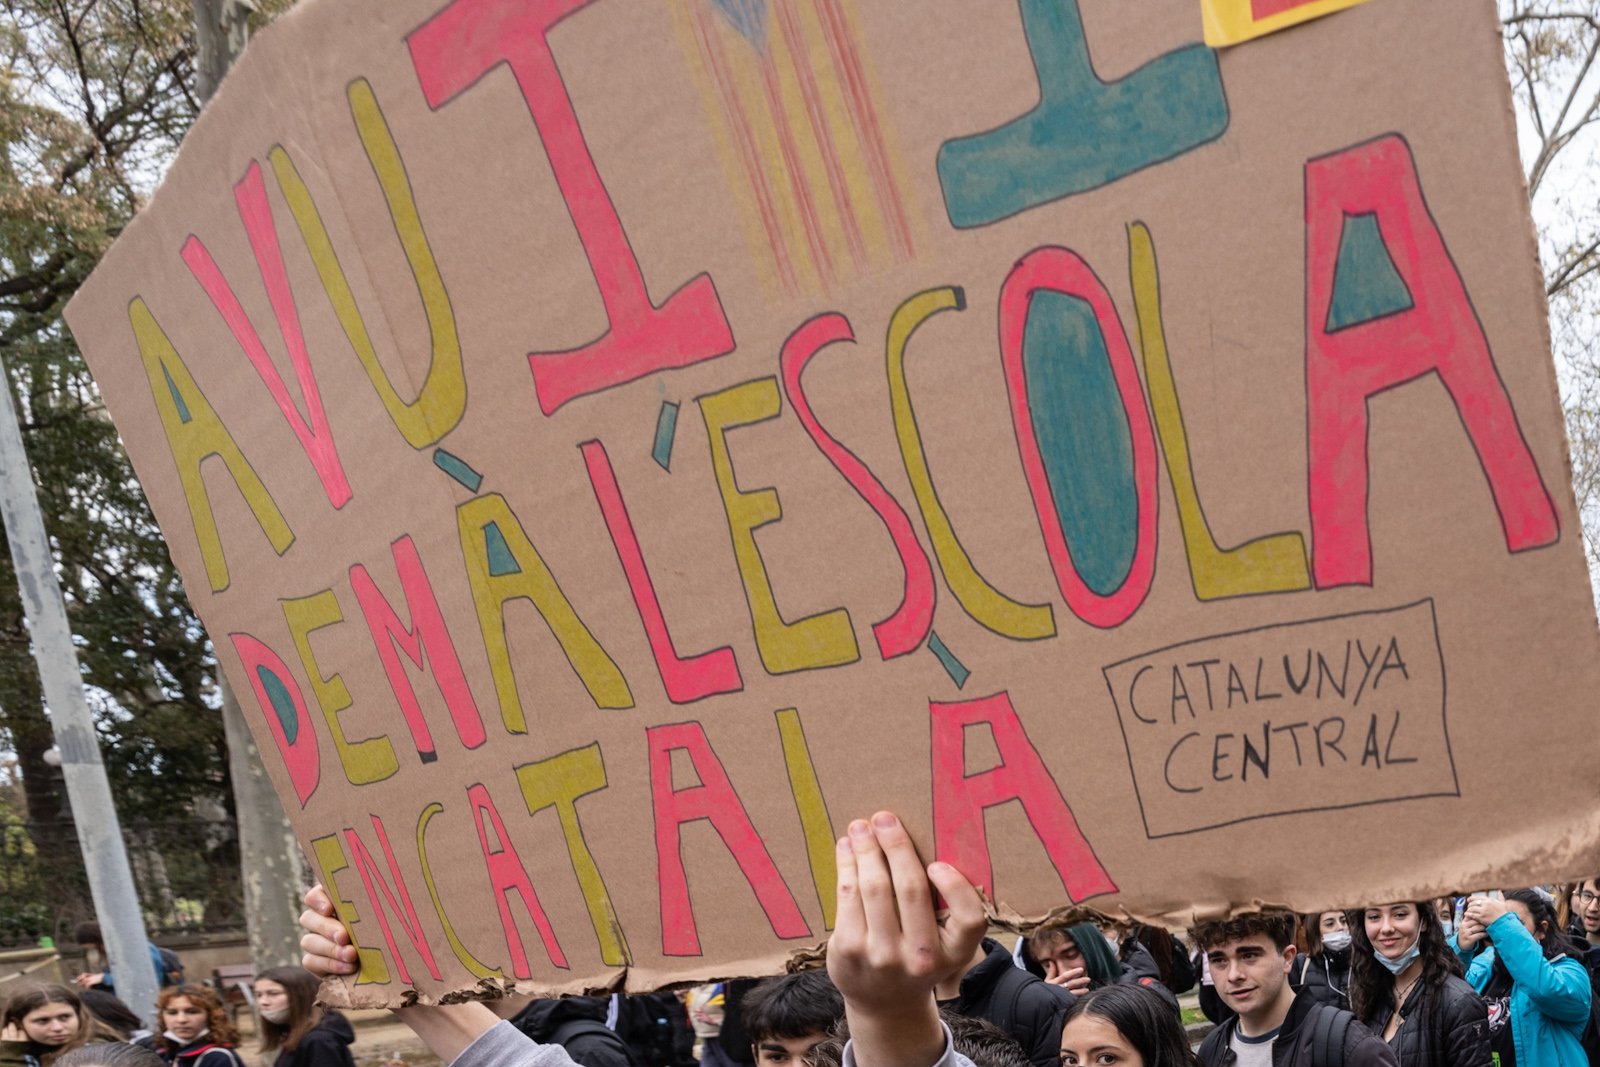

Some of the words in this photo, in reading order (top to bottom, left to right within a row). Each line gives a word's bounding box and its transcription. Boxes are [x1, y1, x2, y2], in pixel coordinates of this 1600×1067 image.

[128, 0, 737, 592] AVUI
[230, 448, 635, 809] DEMÀ
[576, 132, 1560, 705] L'ESCOLA
[1129, 636, 1409, 724] CATALUNYA
[1164, 710, 1418, 793] CENTRAL
